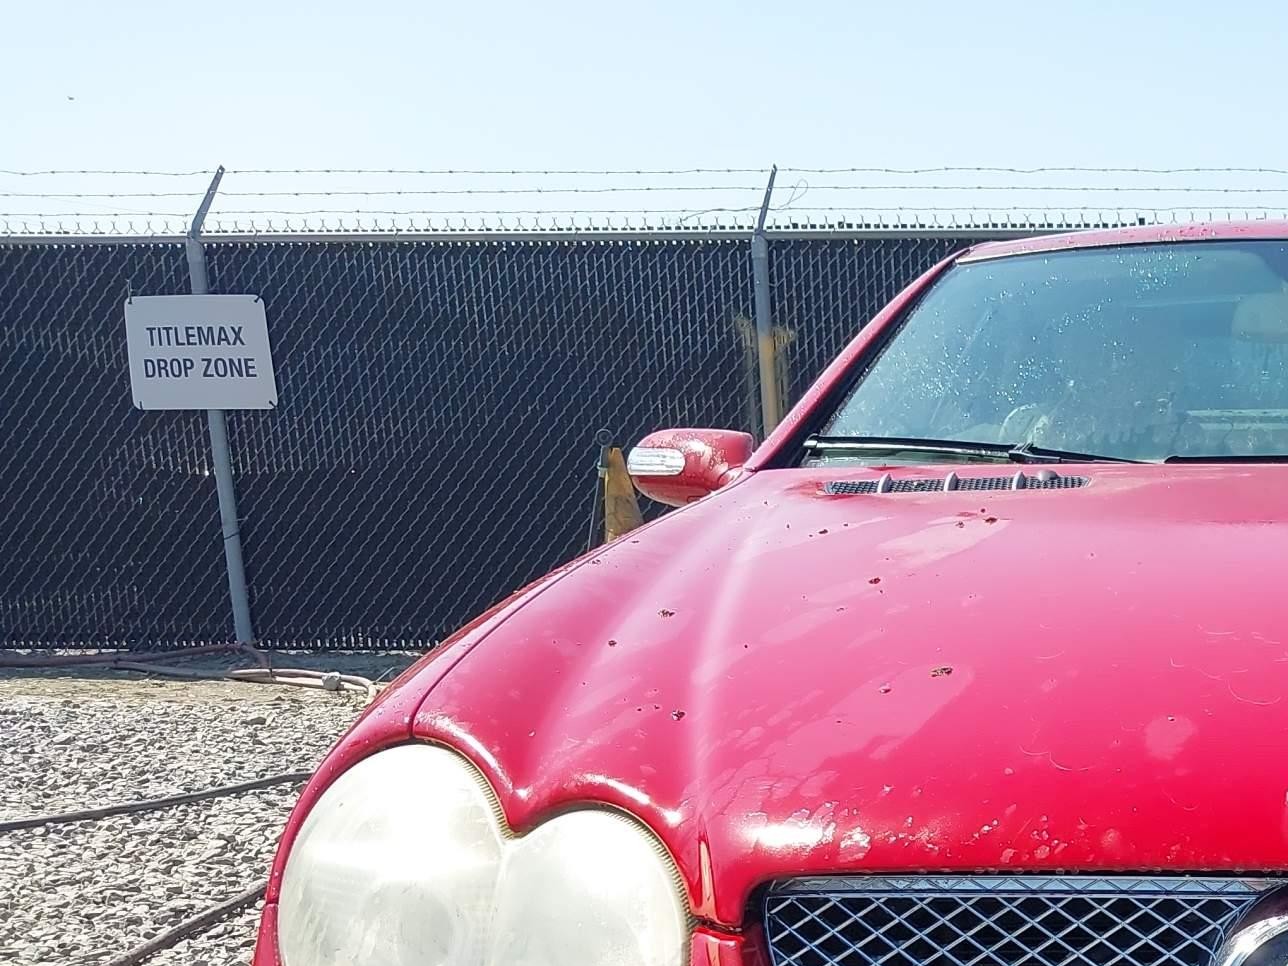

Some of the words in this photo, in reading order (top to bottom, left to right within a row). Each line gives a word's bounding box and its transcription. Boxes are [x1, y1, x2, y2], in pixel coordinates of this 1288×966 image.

[145, 326, 246, 347] TITLEMAX
[143, 358, 195, 378] DROP
[201, 357, 257, 378] ZONE
